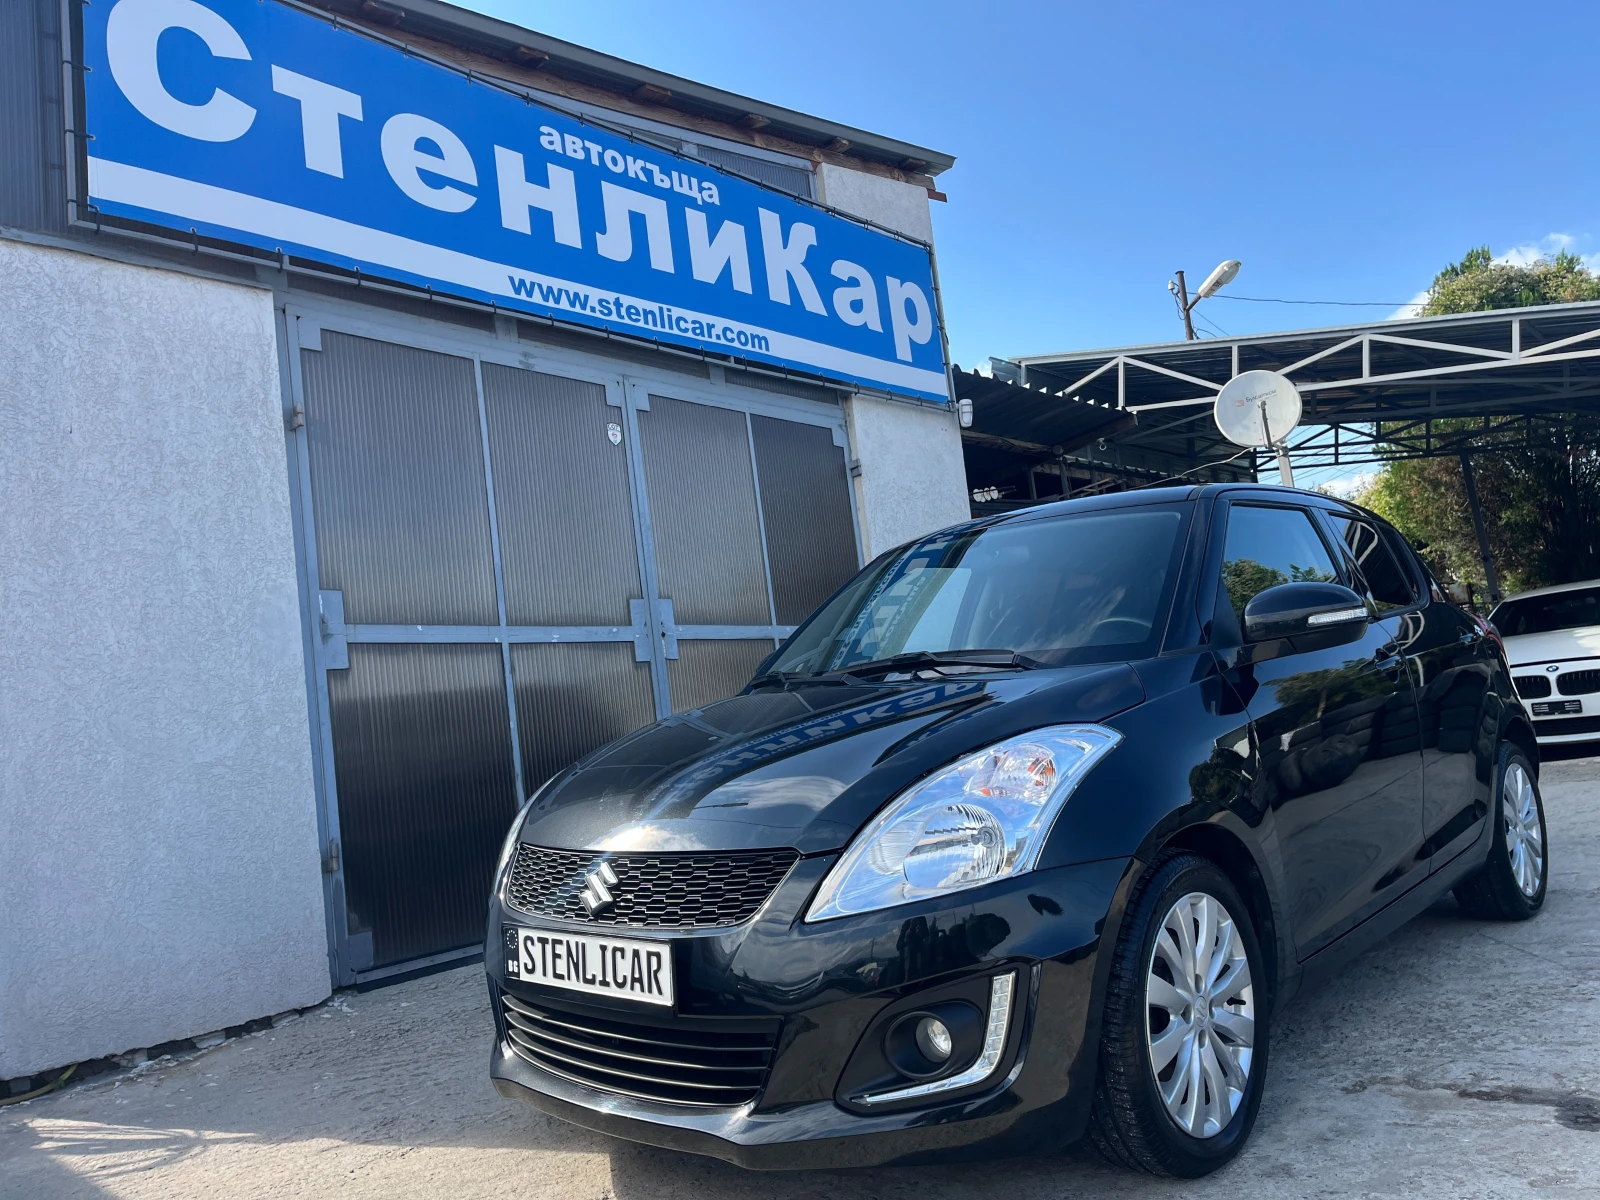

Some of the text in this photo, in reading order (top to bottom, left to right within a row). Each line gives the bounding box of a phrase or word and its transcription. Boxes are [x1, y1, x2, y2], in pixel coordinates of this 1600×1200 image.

[106, 0, 933, 362] СтенлиКар
[539, 125, 720, 206] автокъща
[508, 275, 770, 352] www.stenlicar.com
[508, 959, 518, 973] BG
[523, 934, 663, 996] STENLICAR
